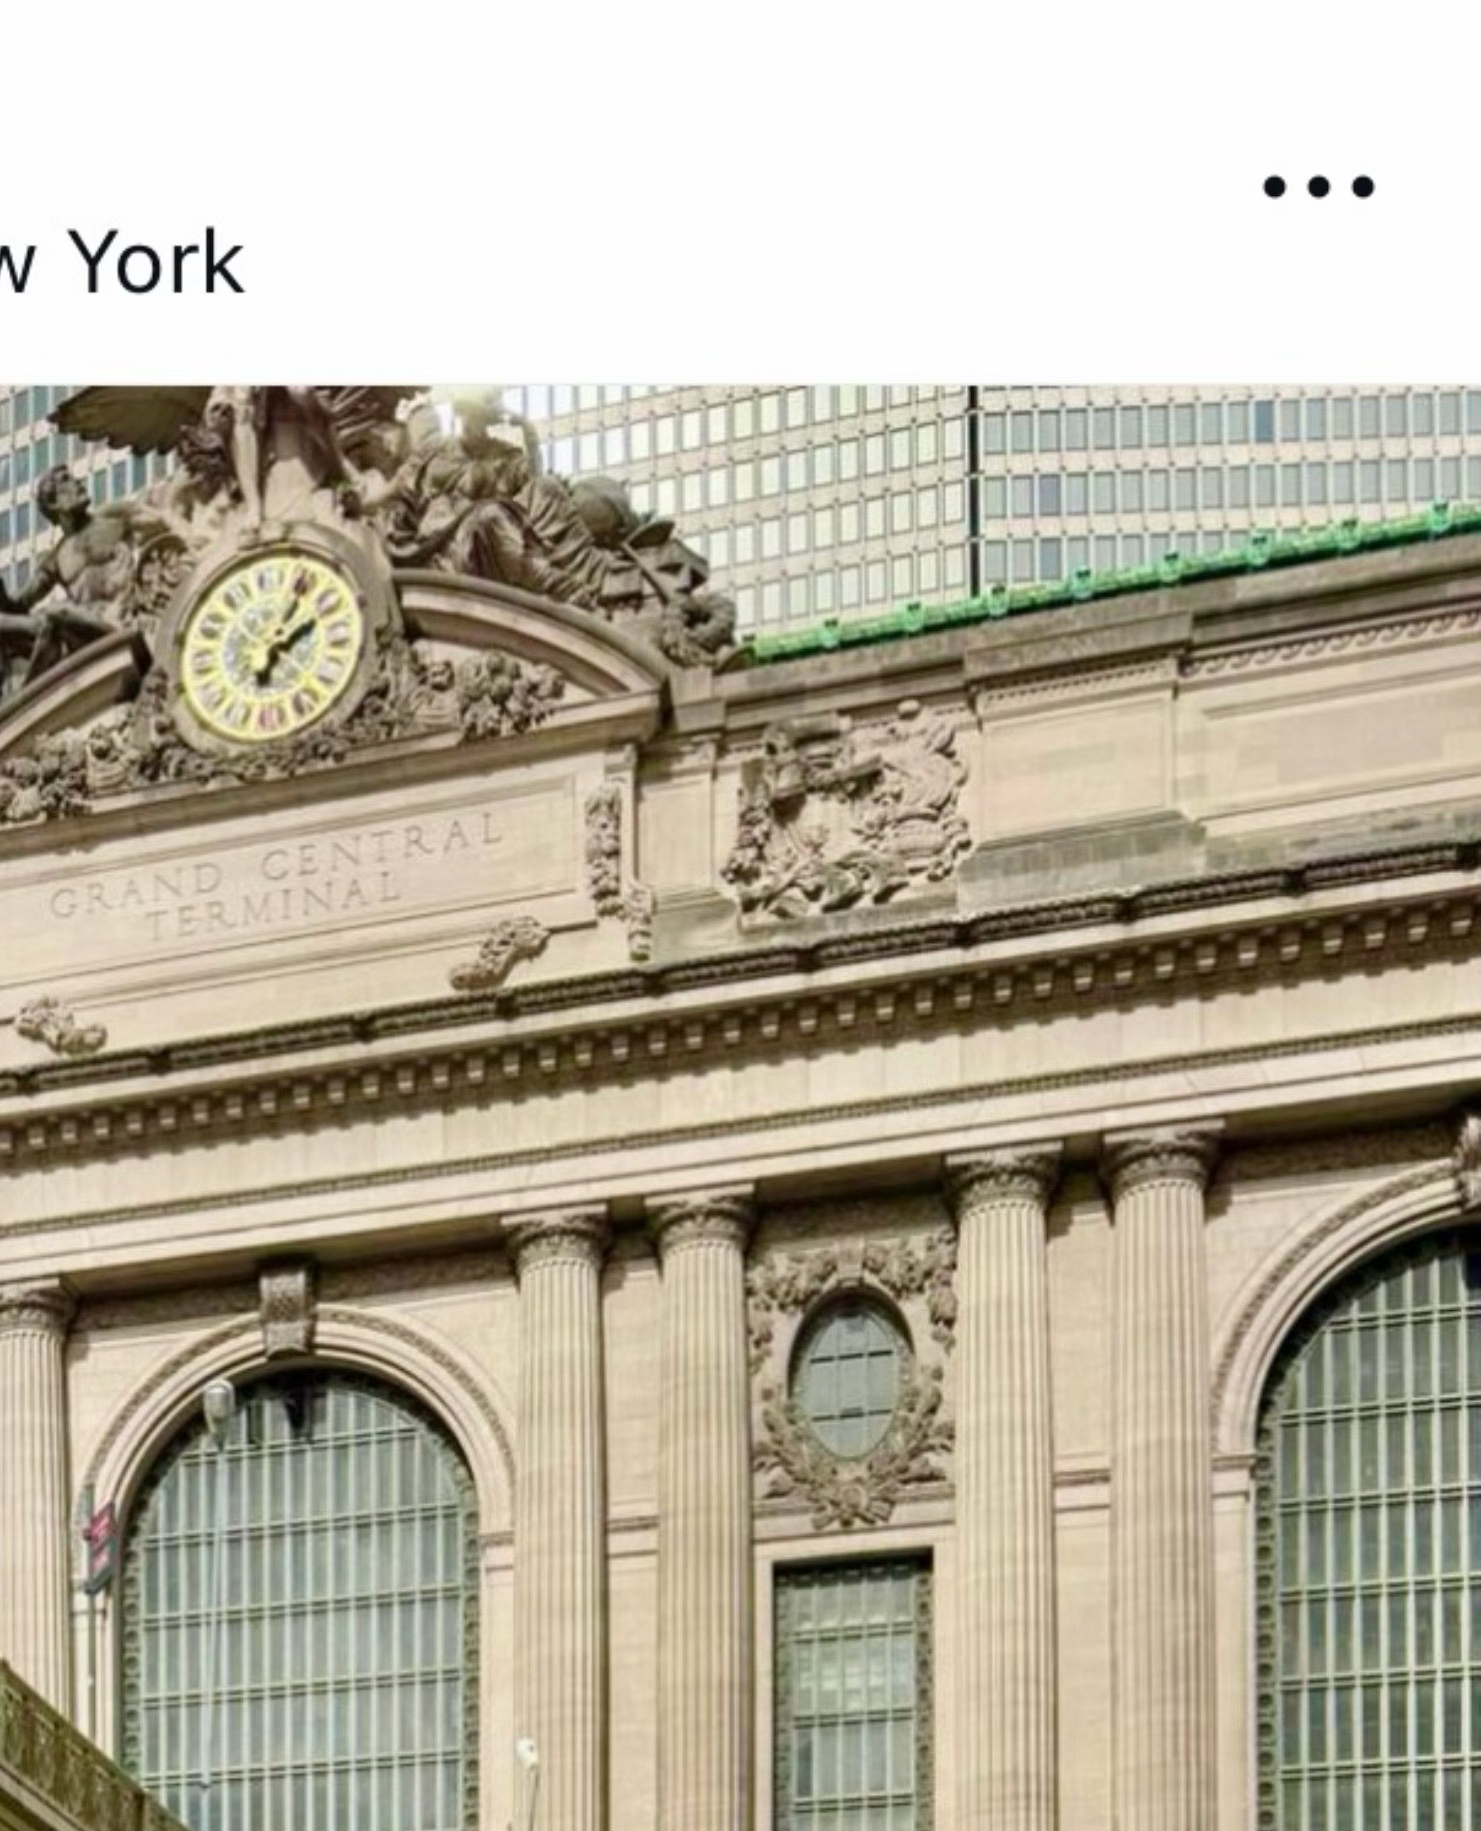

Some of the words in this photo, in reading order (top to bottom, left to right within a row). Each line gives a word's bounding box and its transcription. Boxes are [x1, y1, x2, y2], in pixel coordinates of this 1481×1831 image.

[51, 862, 220, 919] GRAND
[260, 811, 504, 882] CENTRAL
[145, 870, 402, 943] TERMINAL
